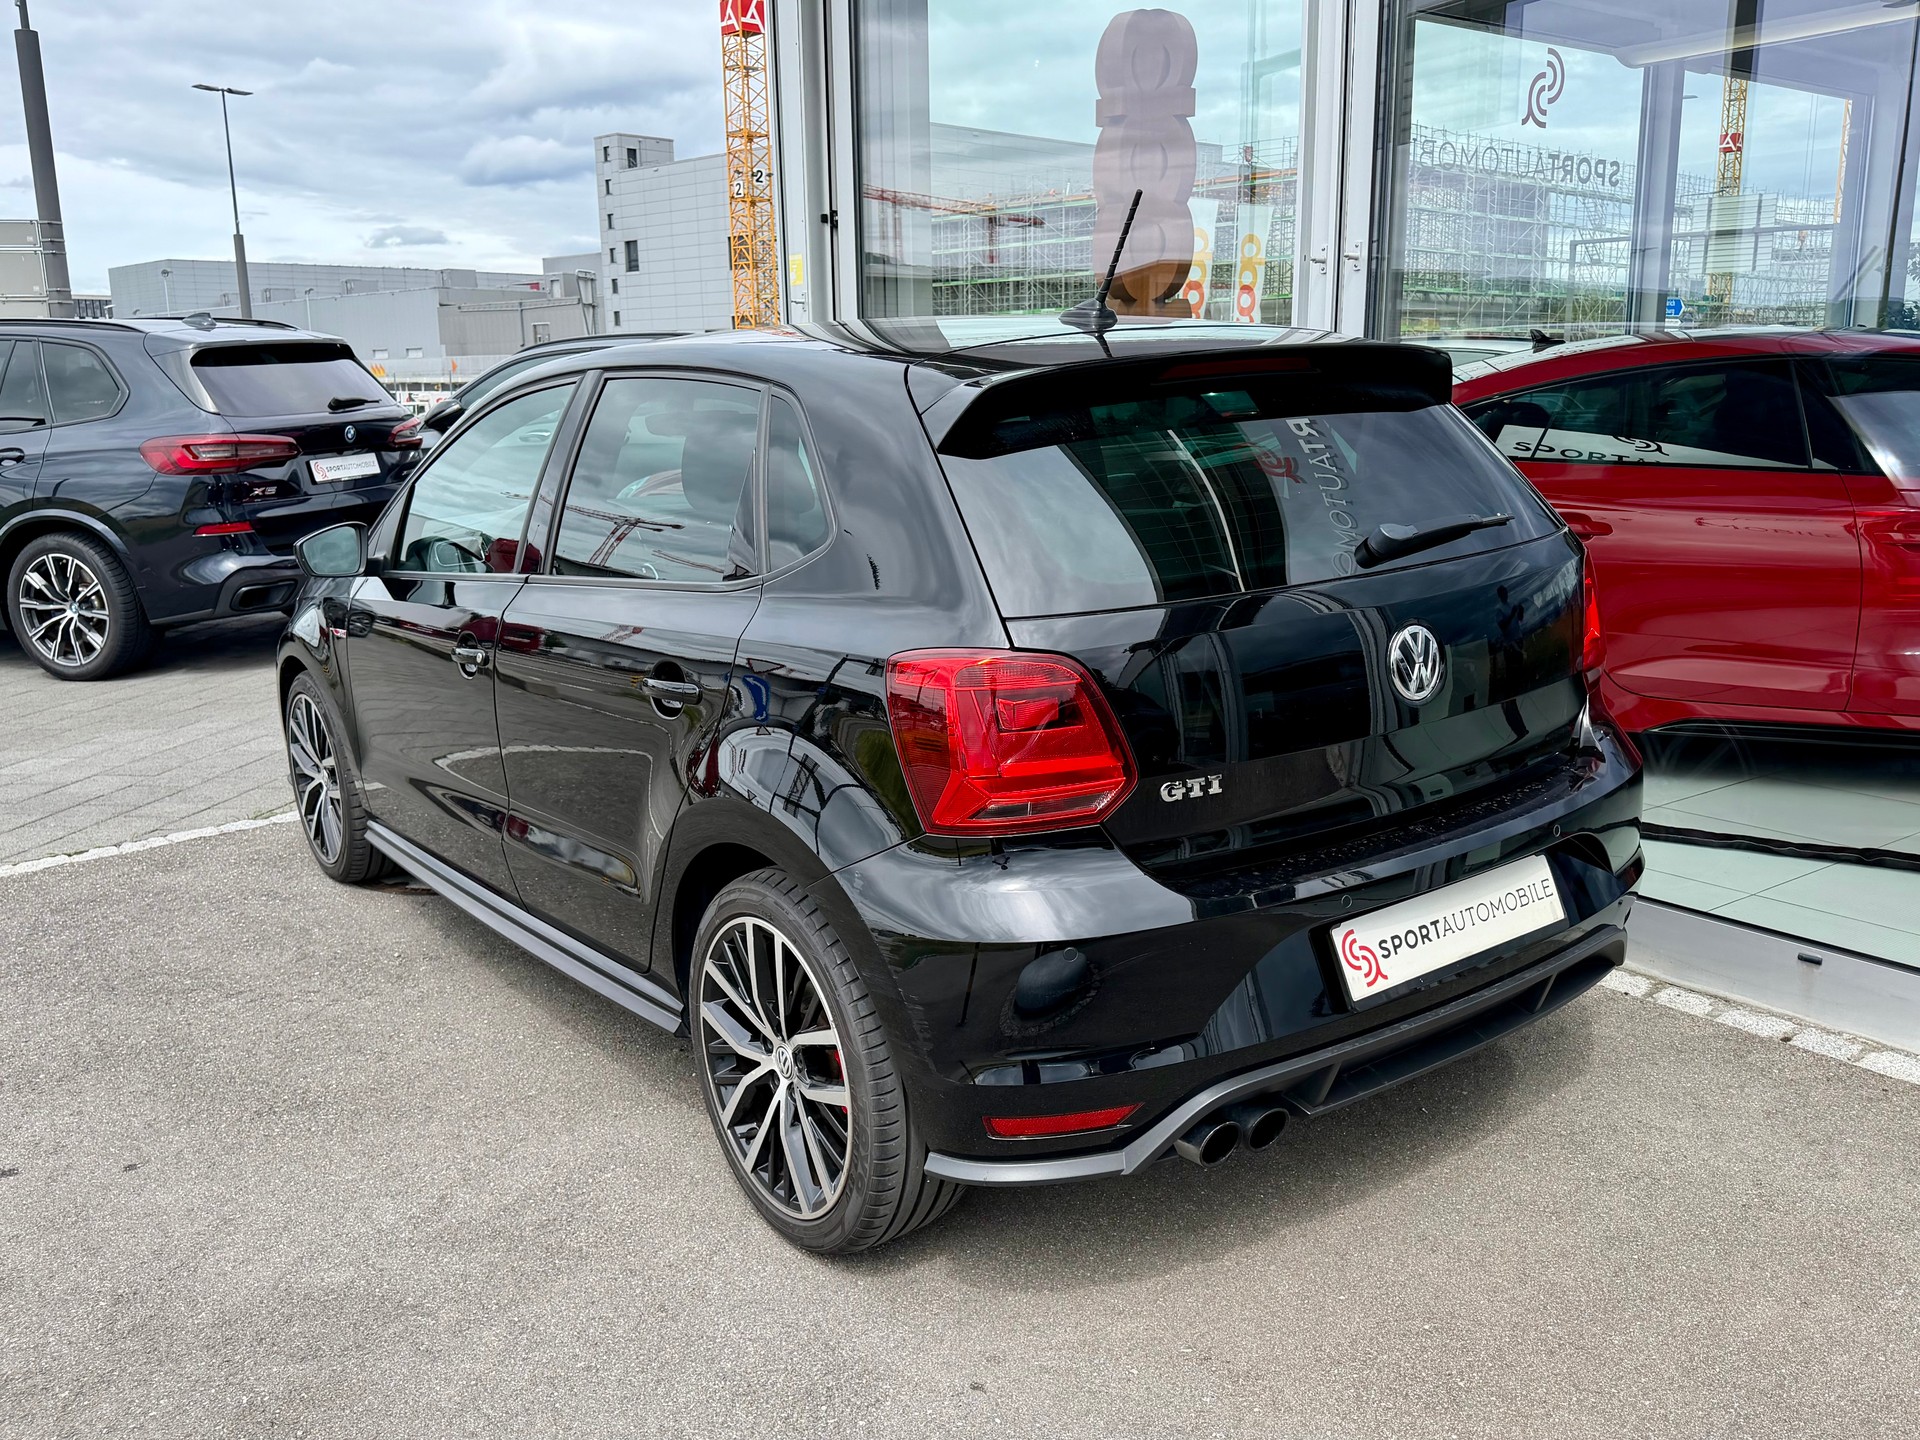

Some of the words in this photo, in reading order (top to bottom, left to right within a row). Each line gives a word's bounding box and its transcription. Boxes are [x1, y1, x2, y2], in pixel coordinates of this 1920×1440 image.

[755, 169, 764, 184] 2
[735, 182, 742, 196] 2
[249, 486, 278, 497] X5
[1159, 773, 1224, 803] GTI
[1377, 877, 1555, 960] SPORTAUTOMOBILE
